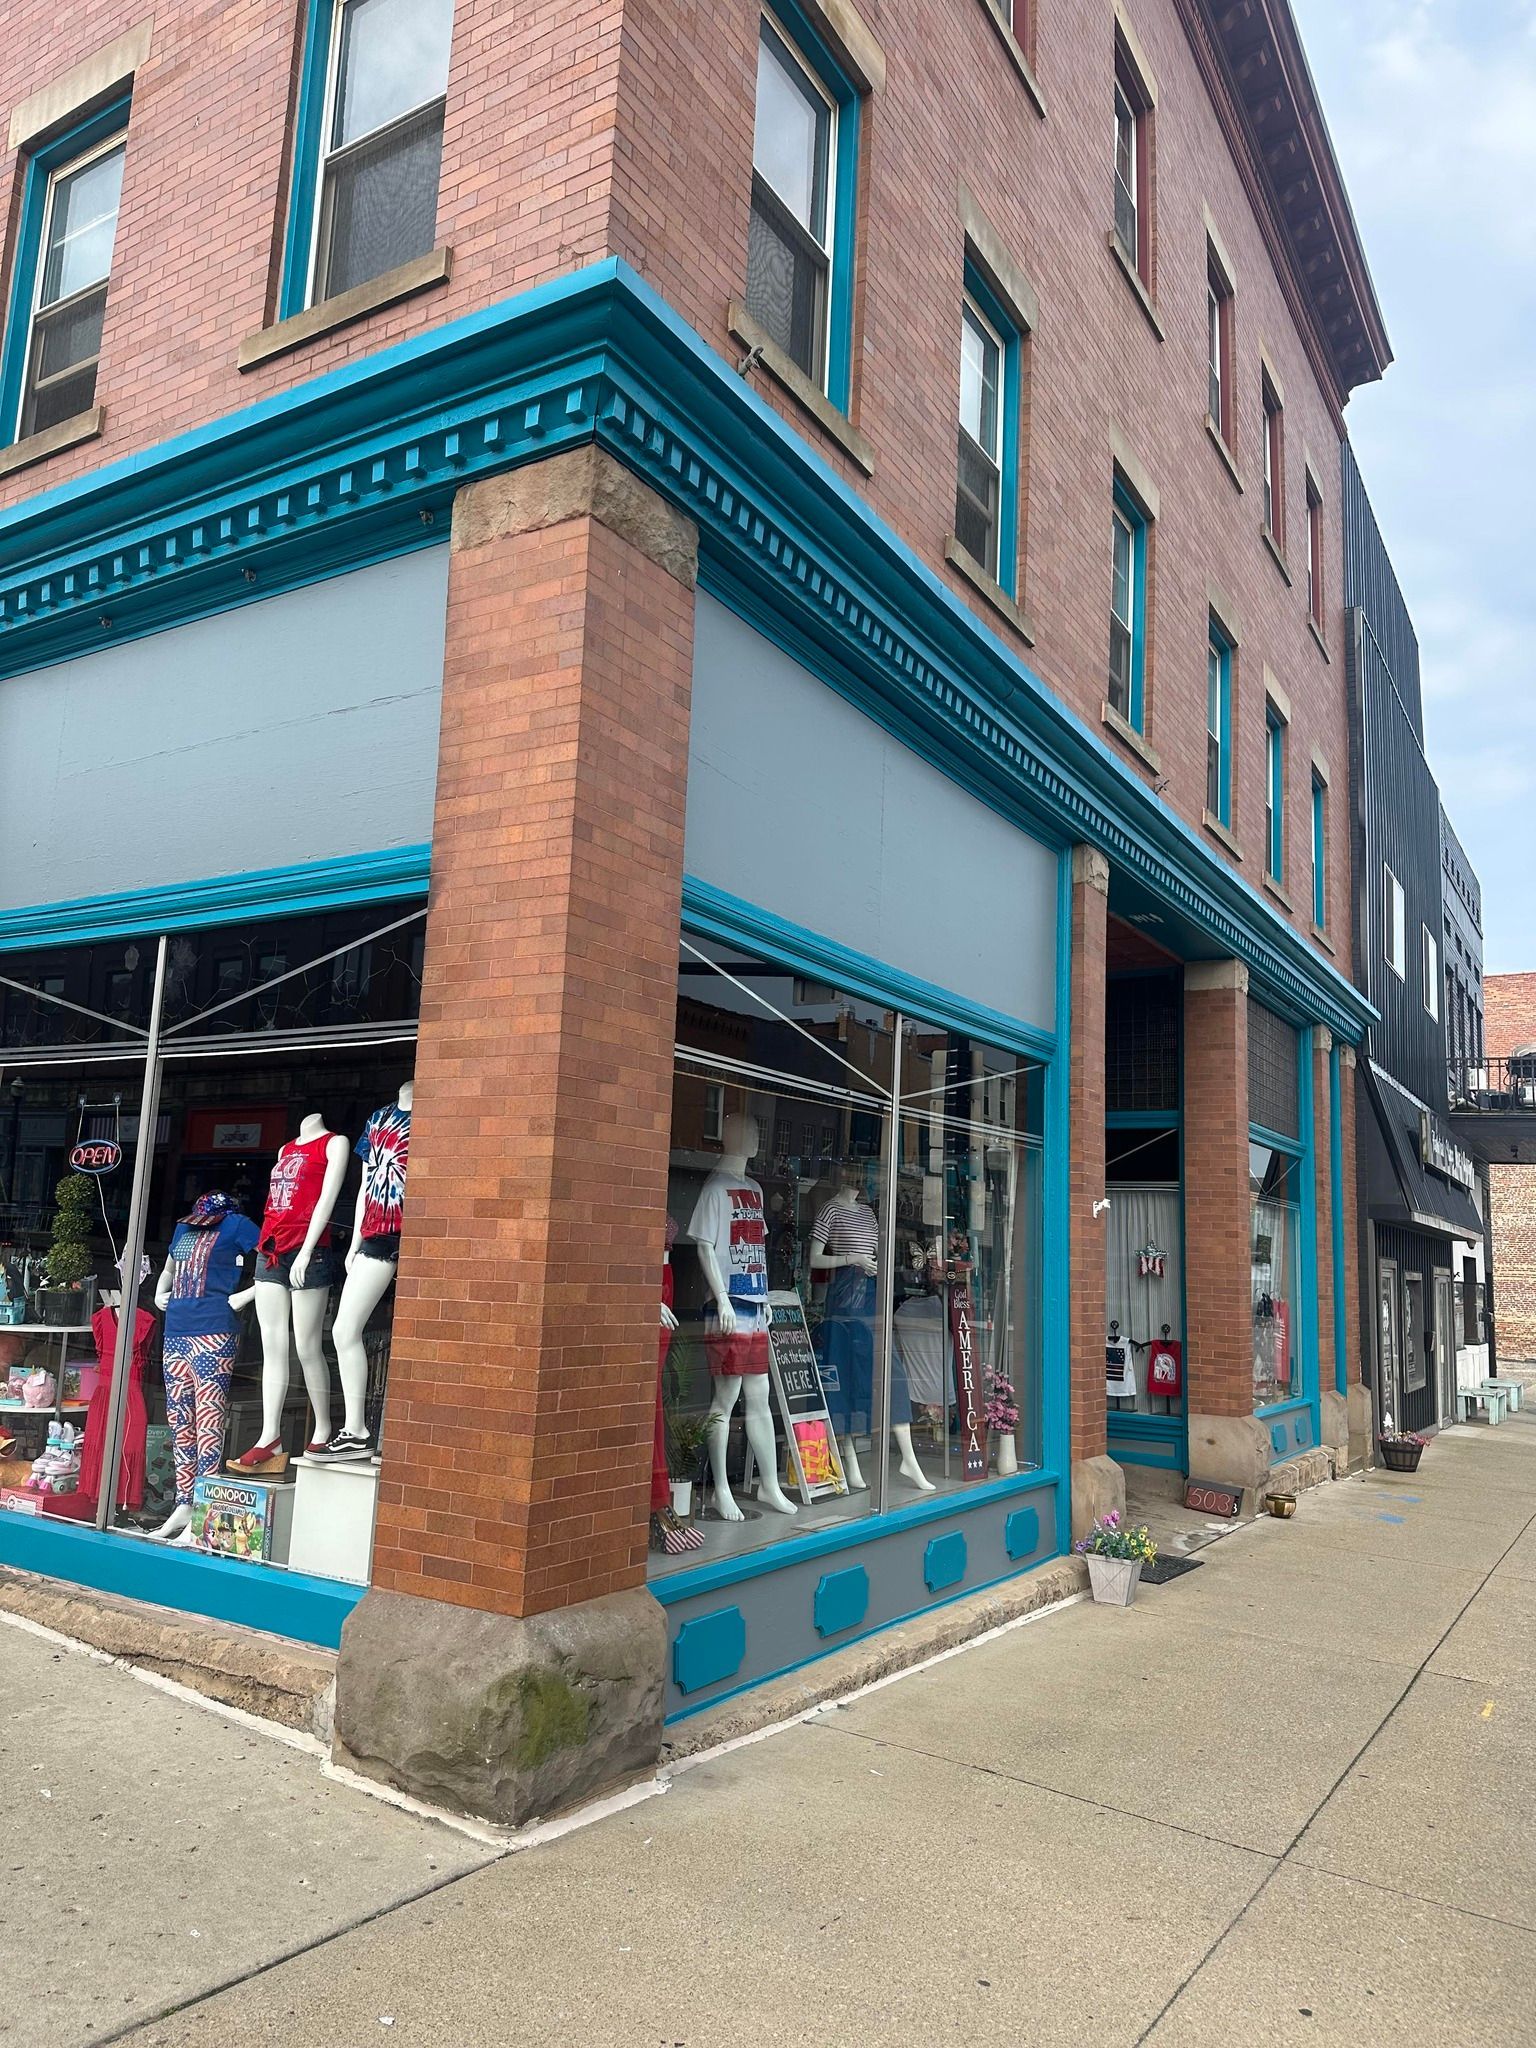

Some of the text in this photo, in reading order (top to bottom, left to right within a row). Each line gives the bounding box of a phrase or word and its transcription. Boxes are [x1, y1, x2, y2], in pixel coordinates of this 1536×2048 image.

[71, 1146, 117, 1165] OPEN
[730, 1220, 765, 1245] RE
[729, 1274, 768, 1295] BLU
[955, 1289, 967, 1299] God
[953, 1298, 970, 1309] Bless
[958, 1311, 981, 1452] AMERICA
[205, 1484, 256, 1505] MONOPOLY
[1189, 1487, 1231, 1513] 503
